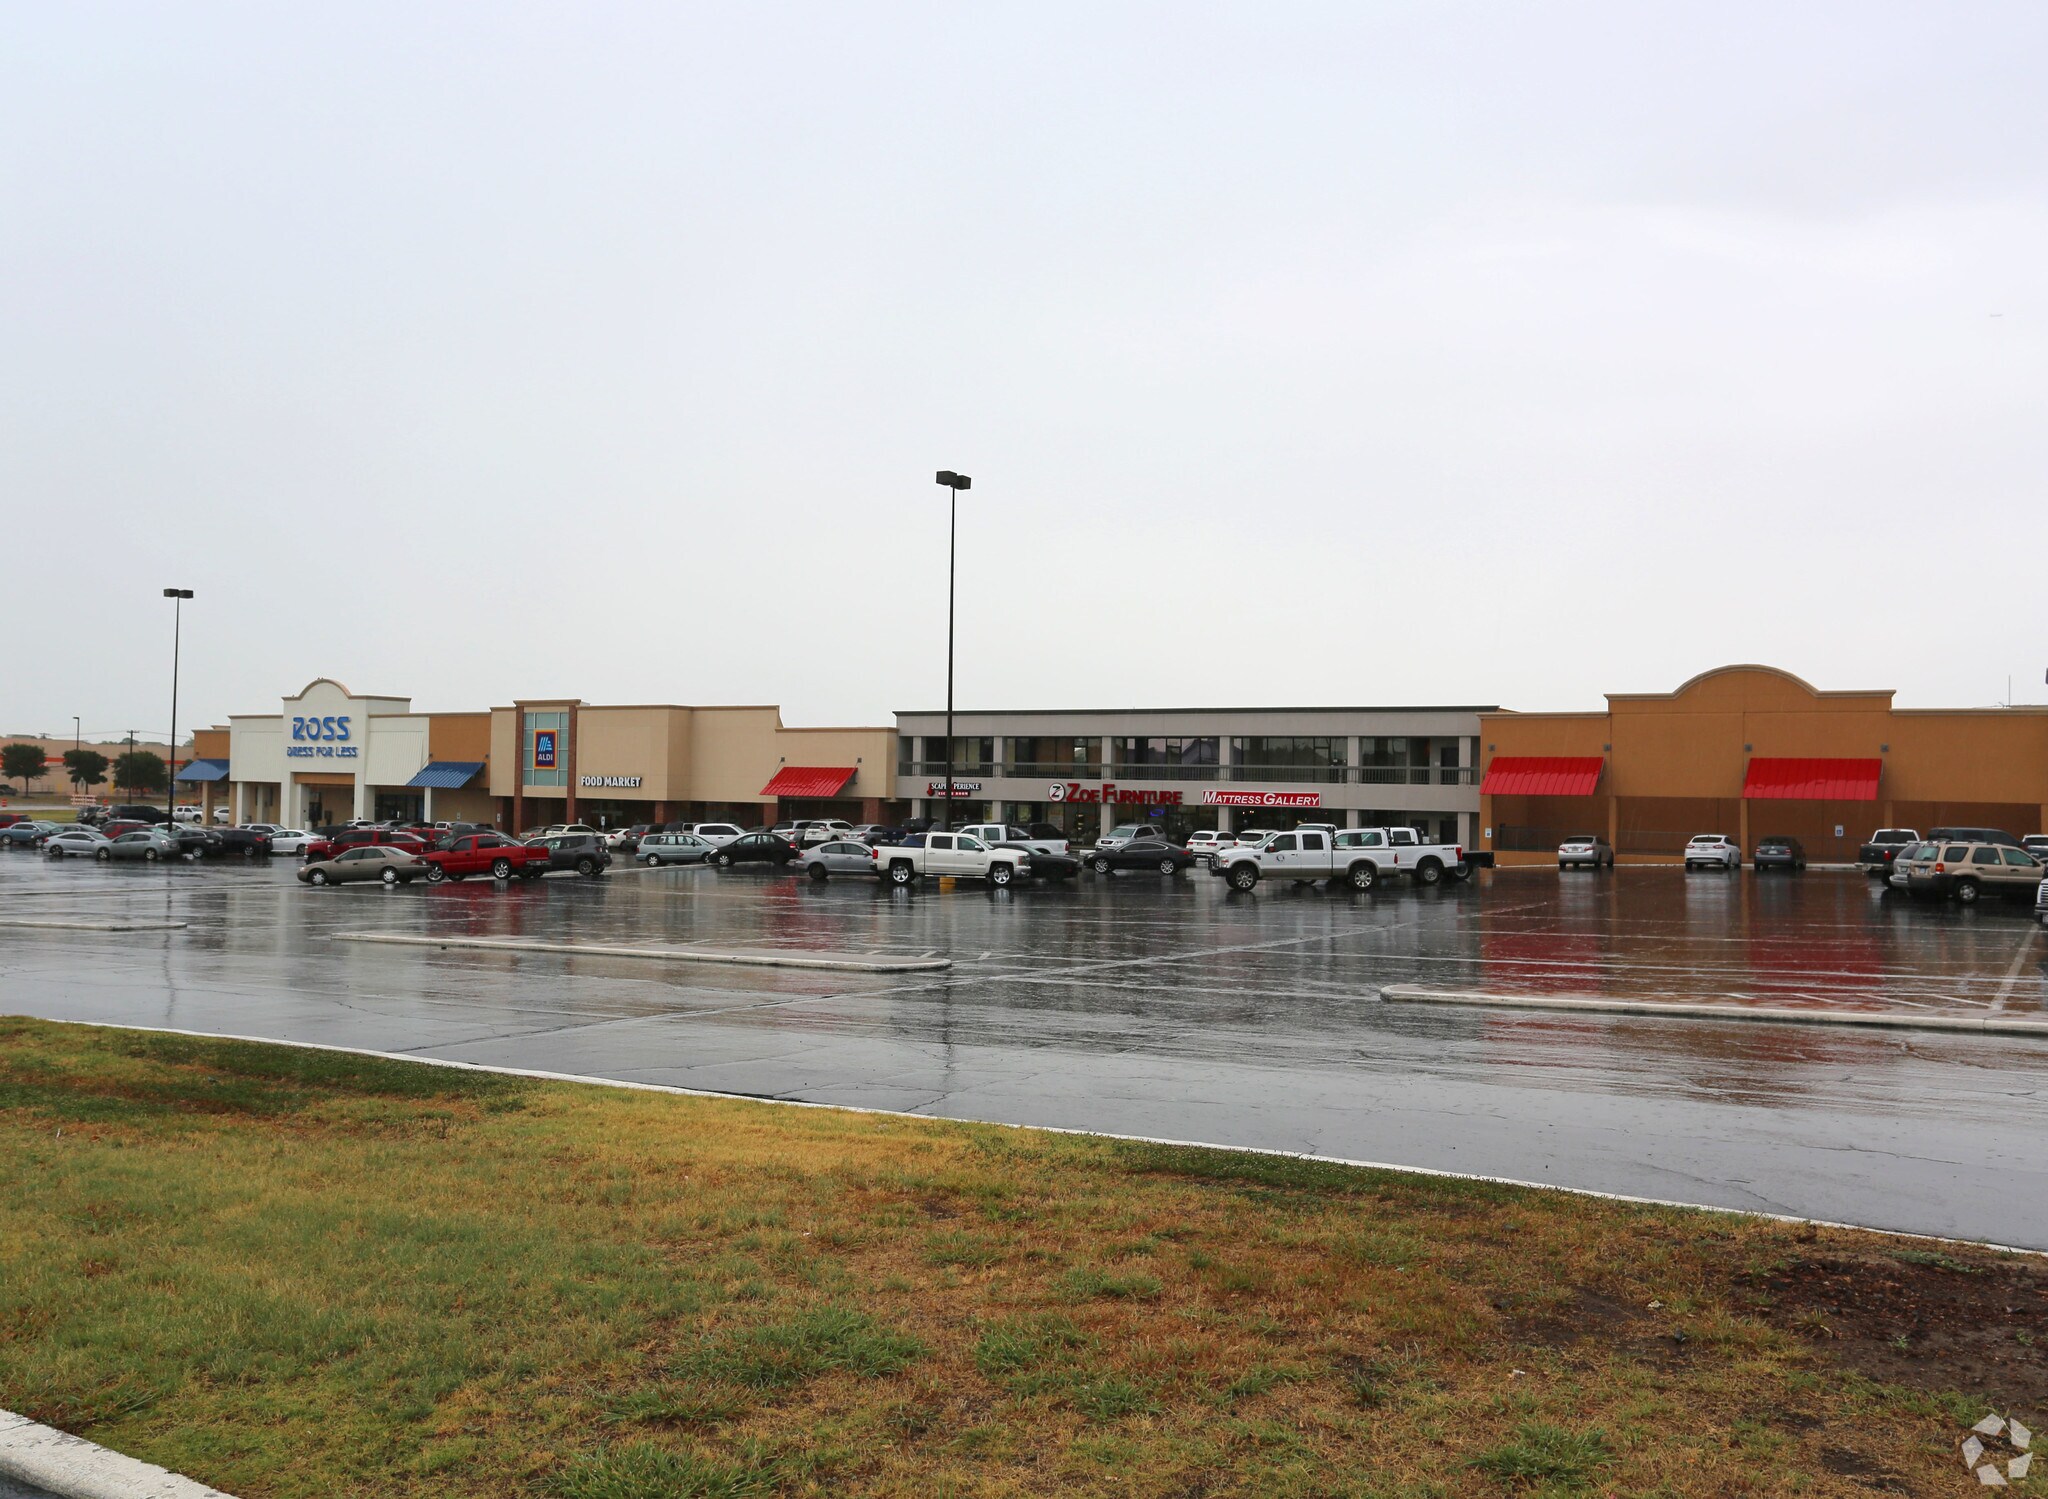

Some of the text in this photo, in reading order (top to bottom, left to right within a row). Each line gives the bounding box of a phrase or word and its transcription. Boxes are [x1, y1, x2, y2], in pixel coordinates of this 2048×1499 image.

[293, 716, 351, 740] ROSS
[287, 746, 359, 757] DRESS FOR LESS
[538, 753, 553, 761] ALDI
[581, 776, 642, 787] FOOD MARKET
[1066, 783, 1184, 805] ZOE FURNITURE
[1203, 791, 1319, 806] MATTRESS GALLERY
